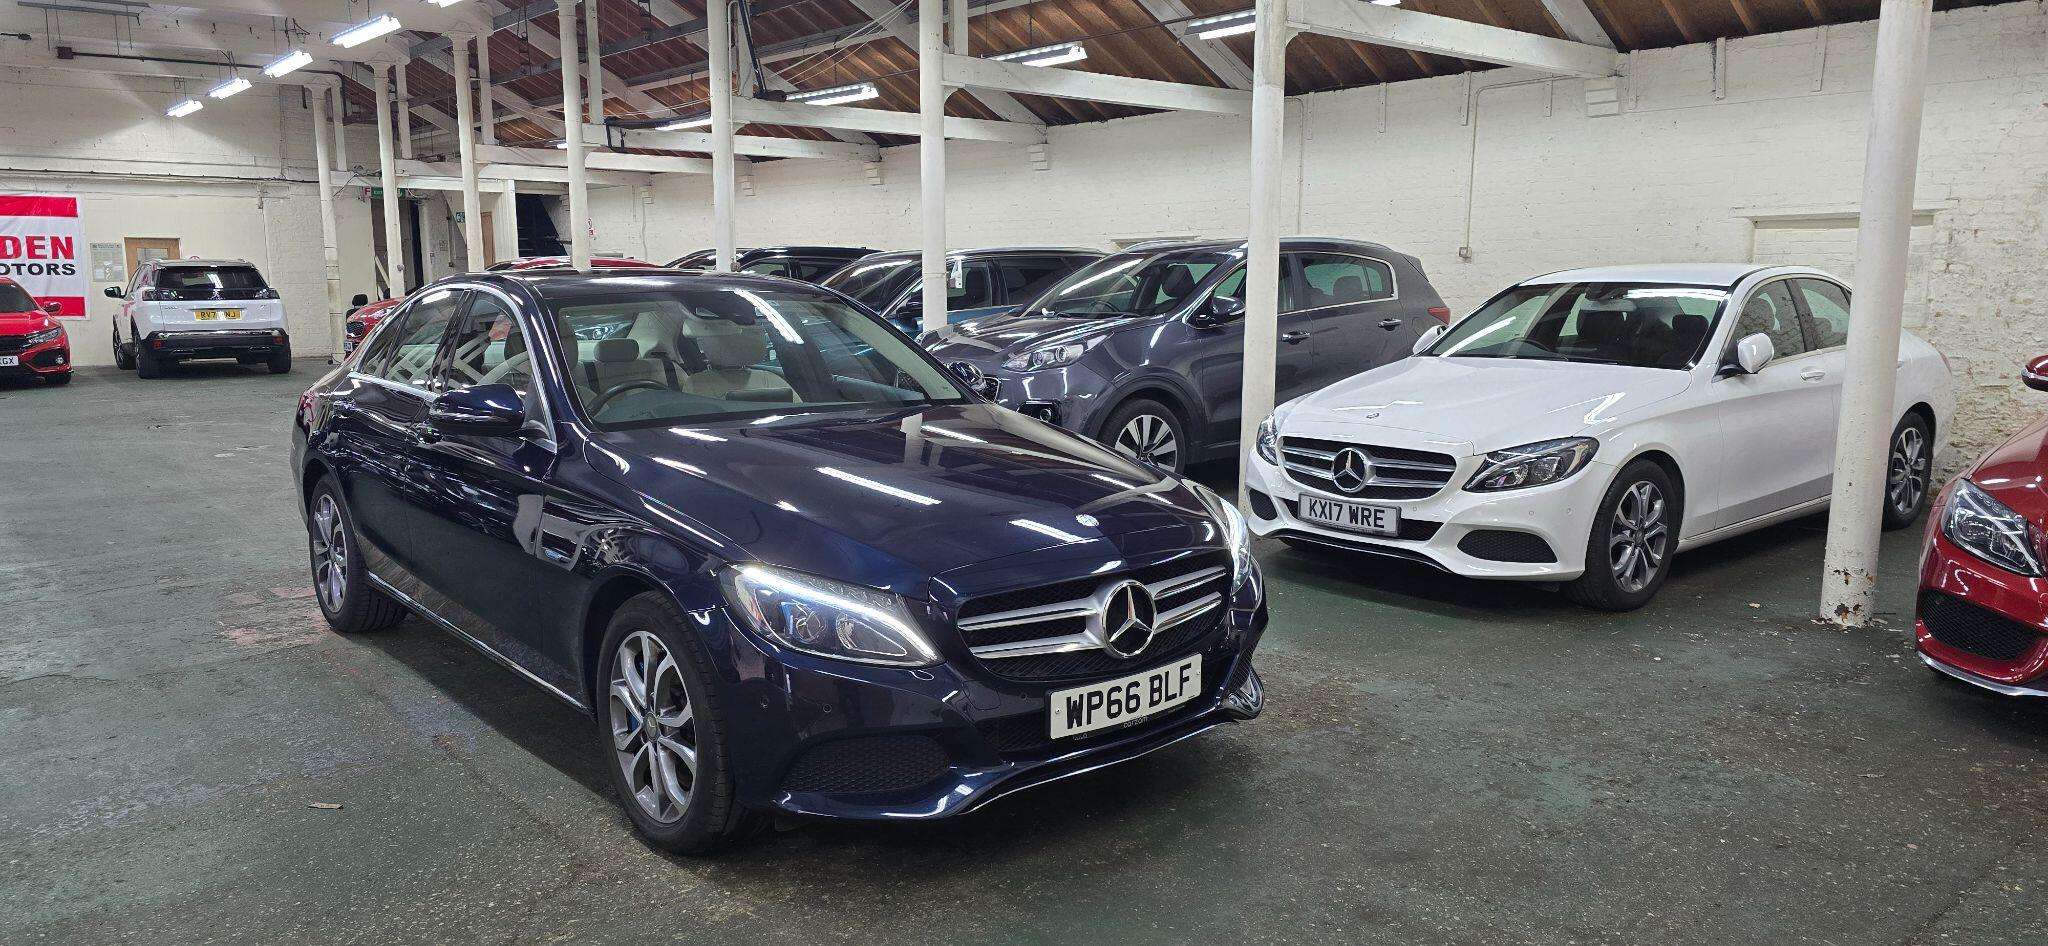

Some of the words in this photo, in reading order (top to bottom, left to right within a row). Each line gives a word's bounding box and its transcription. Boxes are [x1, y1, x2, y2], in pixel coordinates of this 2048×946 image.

[0, 235, 75, 259] DEN
[0, 263, 76, 276] OTORS
[1309, 498, 1343, 522] KX17
[1348, 504, 1385, 529] WRE
[1066, 680, 1141, 730] WP66
[1149, 662, 1192, 708] BLF
